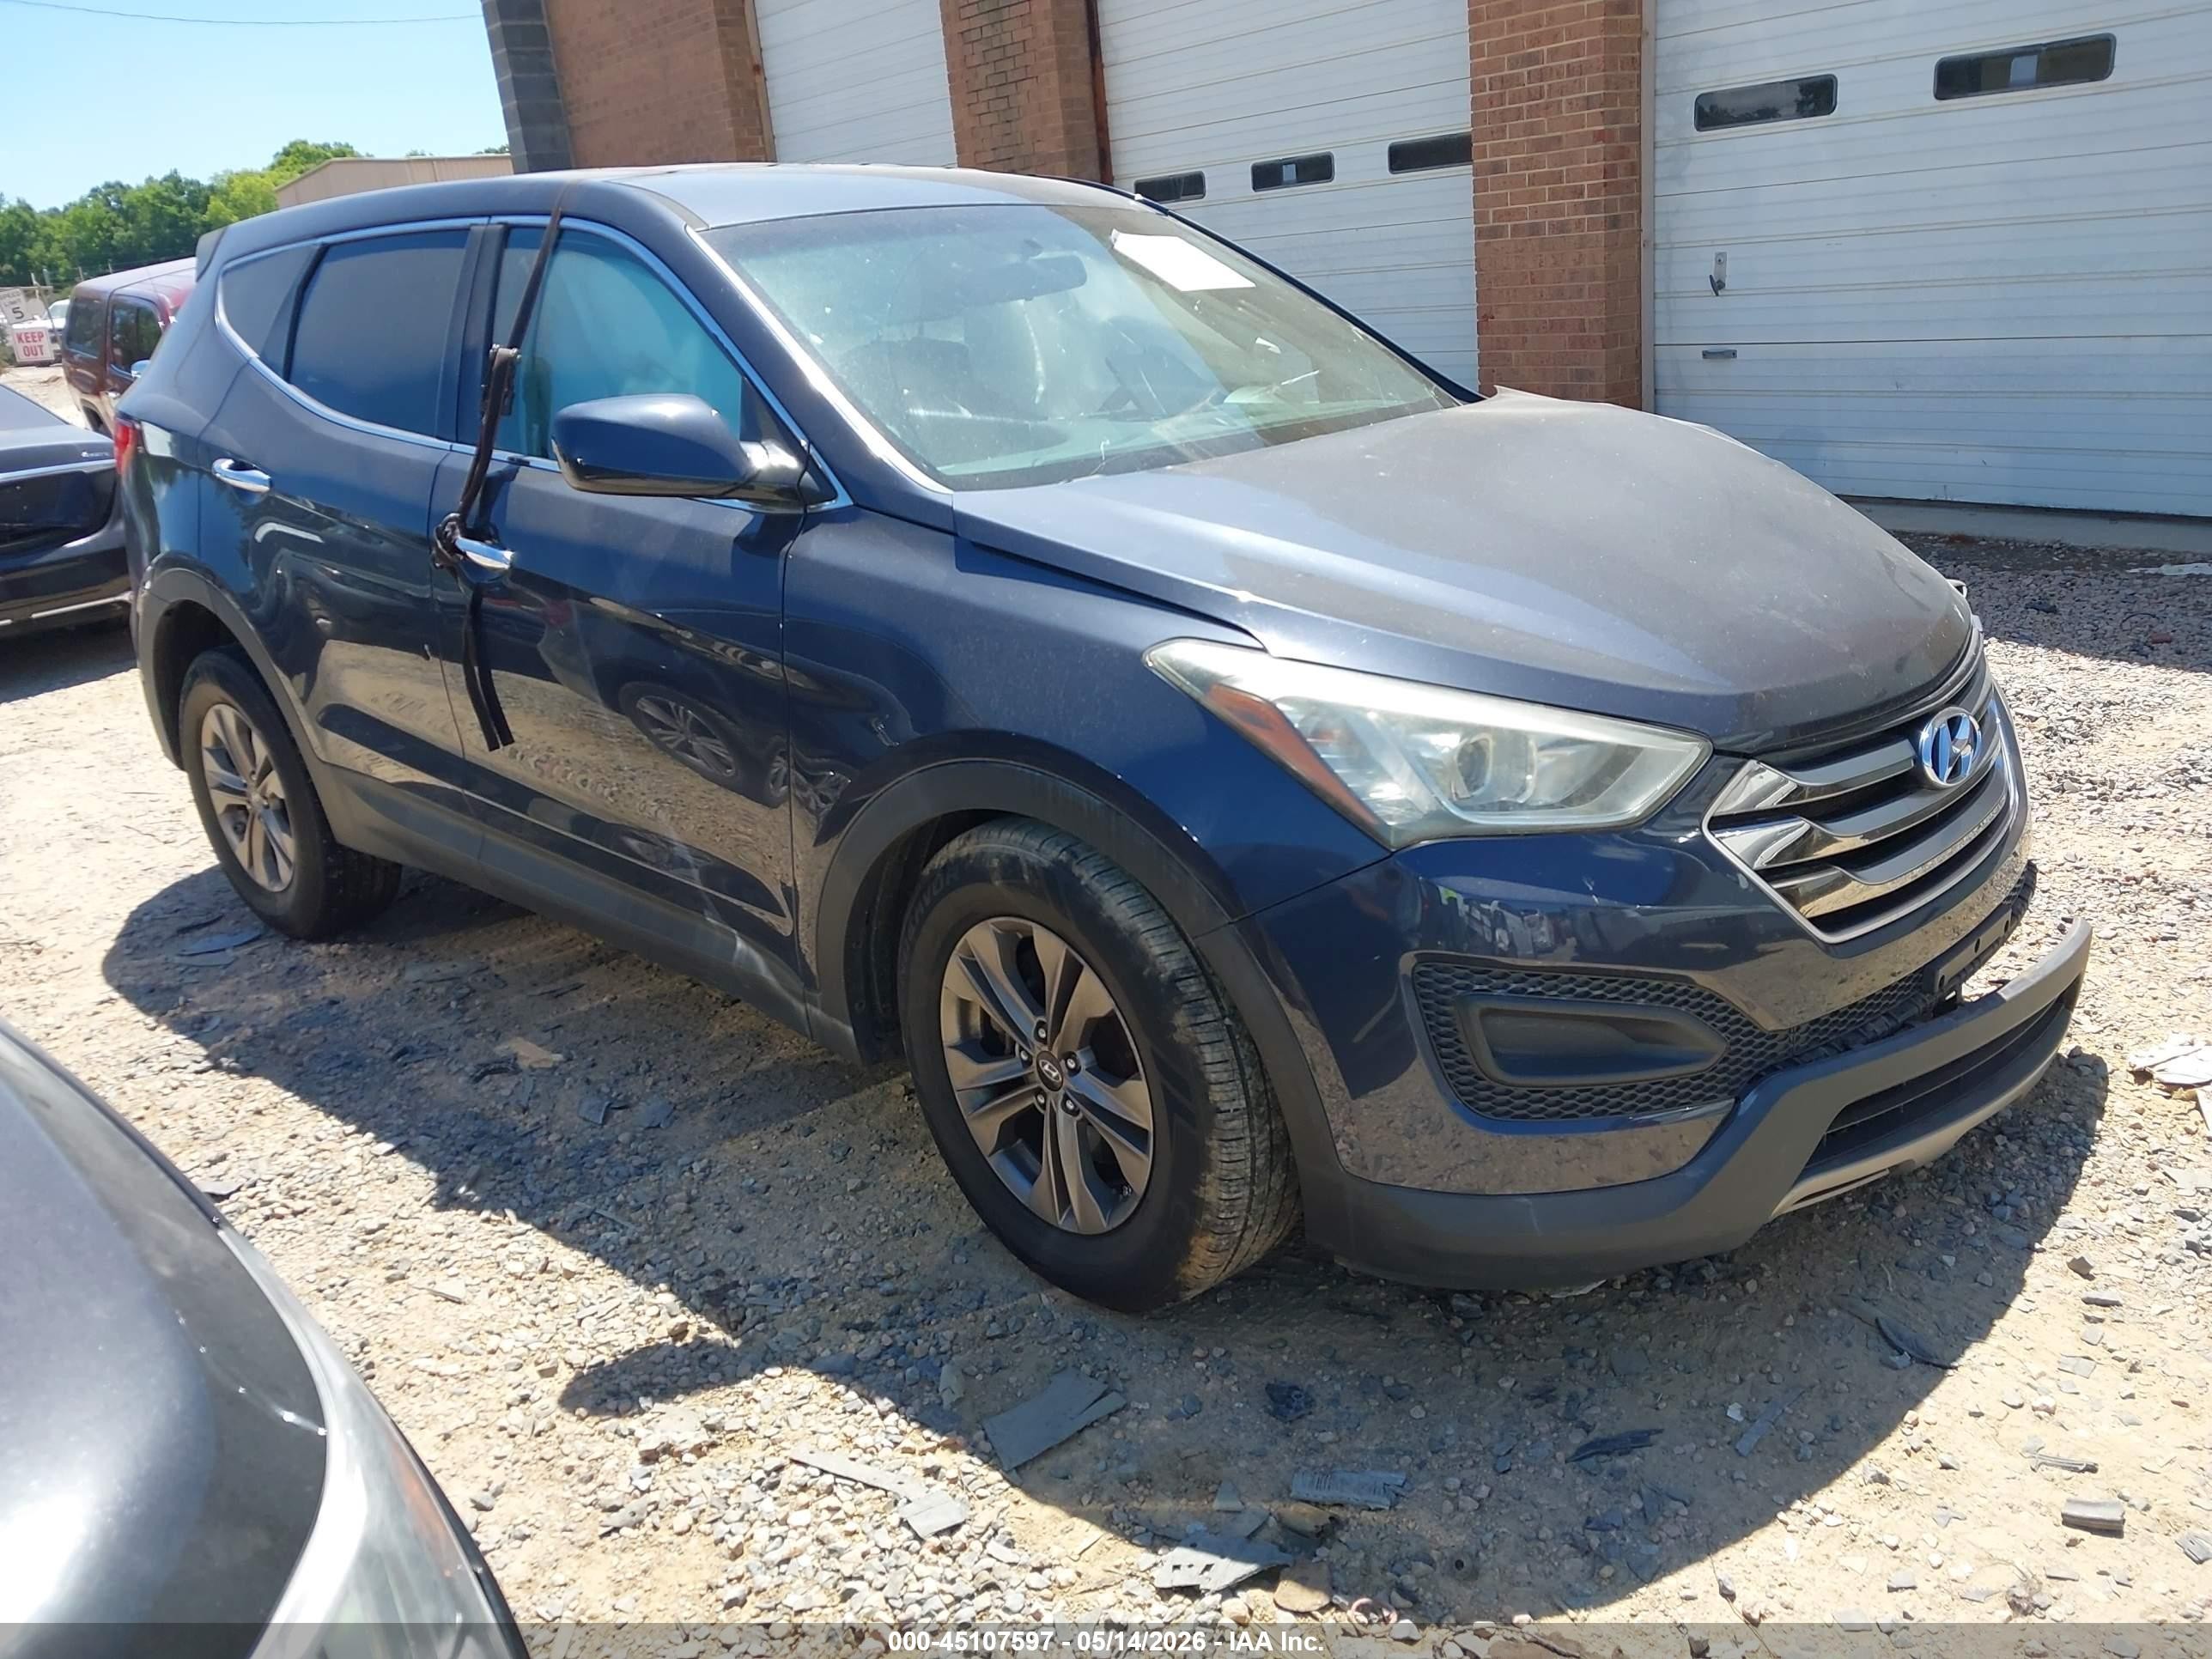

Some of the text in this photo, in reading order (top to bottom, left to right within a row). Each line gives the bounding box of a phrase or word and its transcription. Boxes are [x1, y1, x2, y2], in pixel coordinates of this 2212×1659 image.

[11, 307, 25, 319] 5
[16, 331, 45, 343] KEEP
[22, 345, 44, 357] OUT
